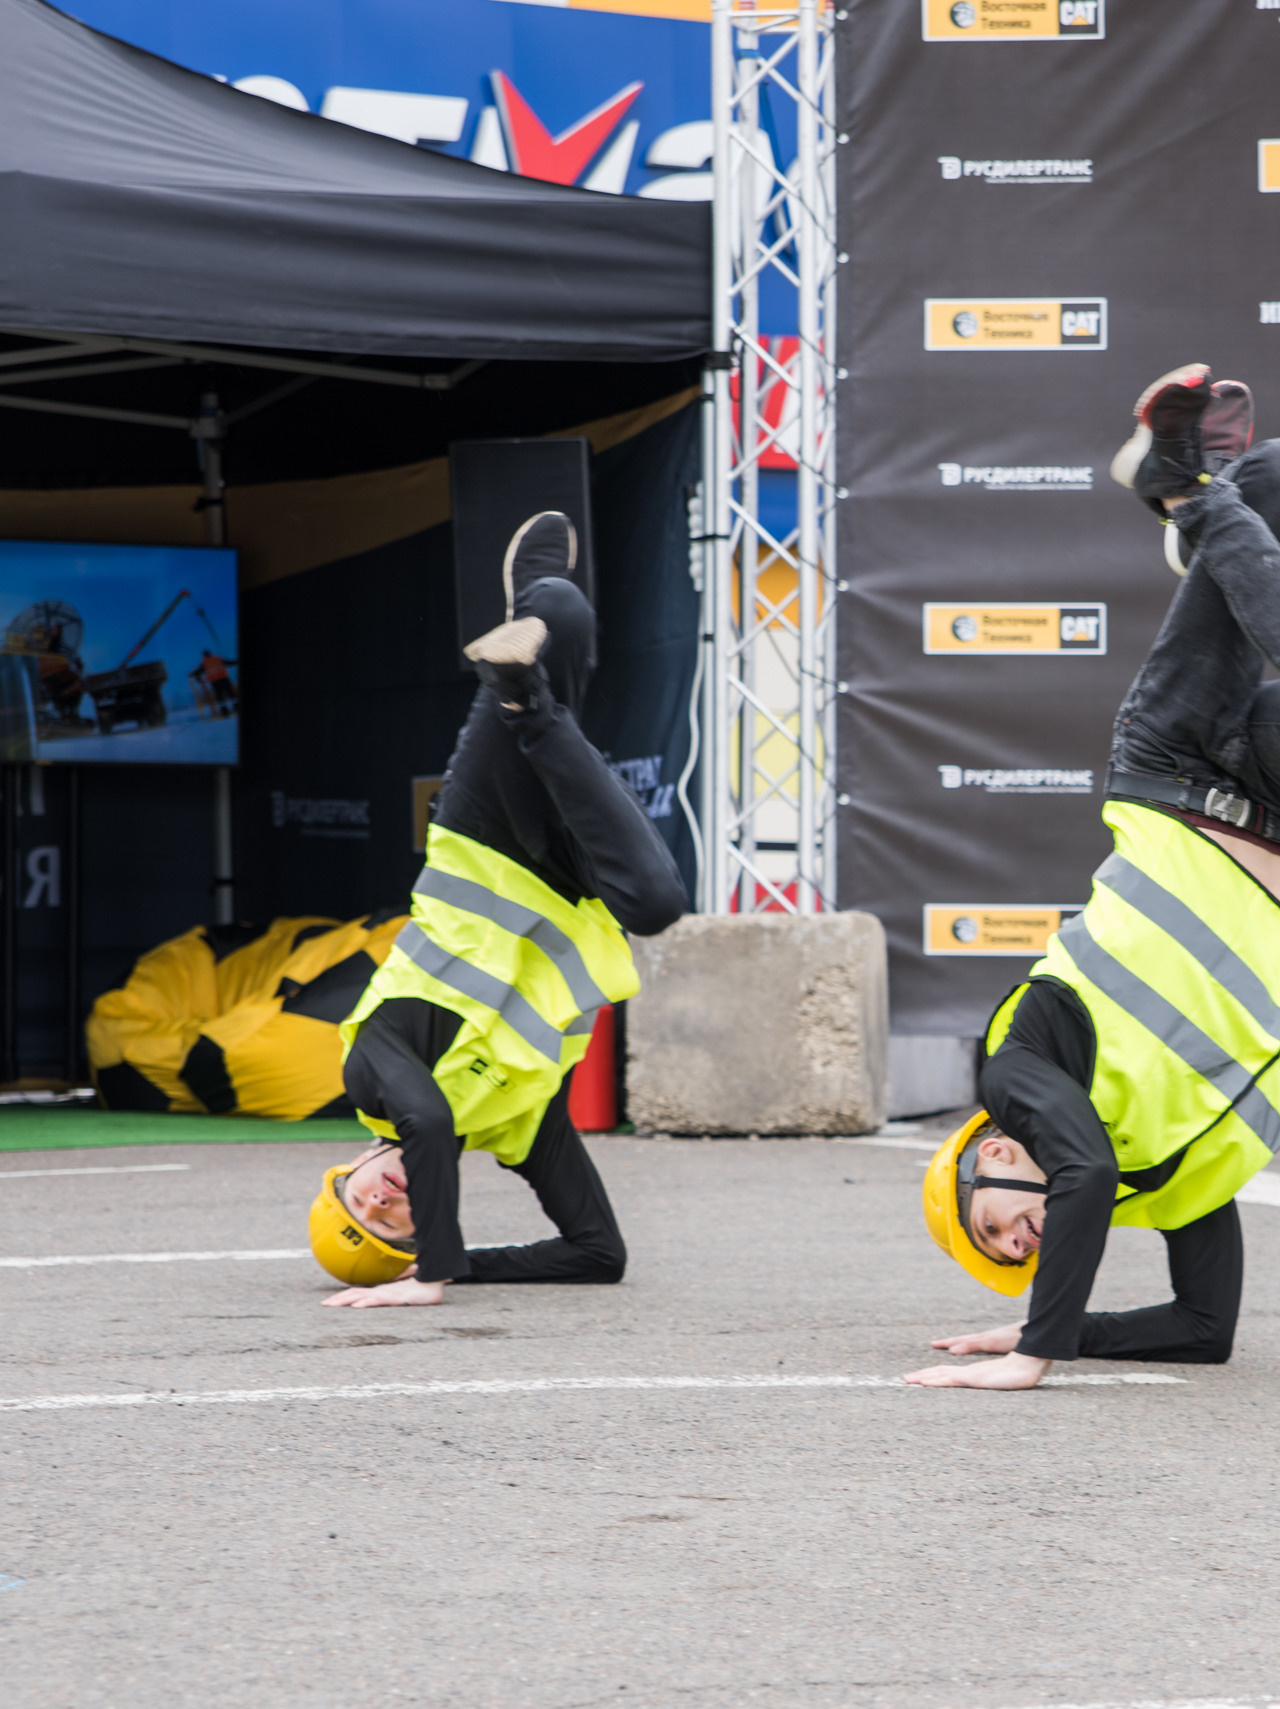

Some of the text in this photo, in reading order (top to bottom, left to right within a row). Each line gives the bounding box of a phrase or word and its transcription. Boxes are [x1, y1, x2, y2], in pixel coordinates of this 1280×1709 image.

[1060, 0, 1098, 26] CAT
[1061, 311, 1100, 336] CAT
[1060, 616, 1099, 641] CAT
